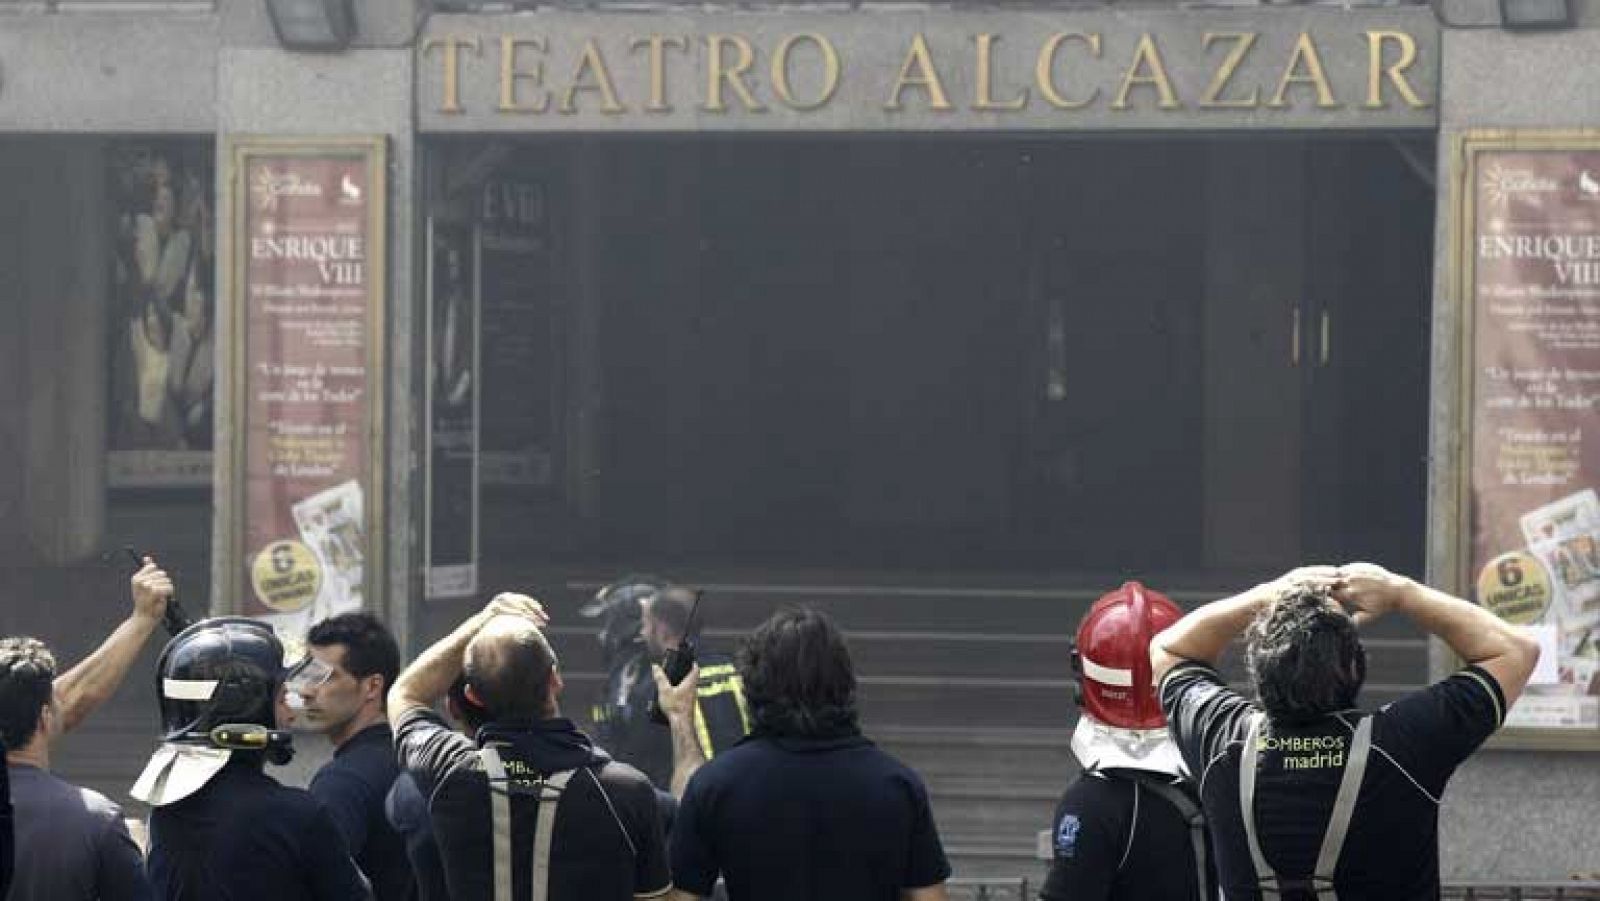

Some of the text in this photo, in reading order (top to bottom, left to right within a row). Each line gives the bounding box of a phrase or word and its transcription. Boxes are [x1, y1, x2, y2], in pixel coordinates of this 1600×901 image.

[422, 29, 1433, 115] TEATRO ALCAZAR
[251, 236, 363, 260] ENRIQUE
[1480, 234, 1600, 261] ENRIQUE
[319, 261, 363, 284] VIII
[1554, 261, 1600, 284] VIII
[1497, 558, 1523, 587] 6
[1283, 750, 1343, 769] madrid
